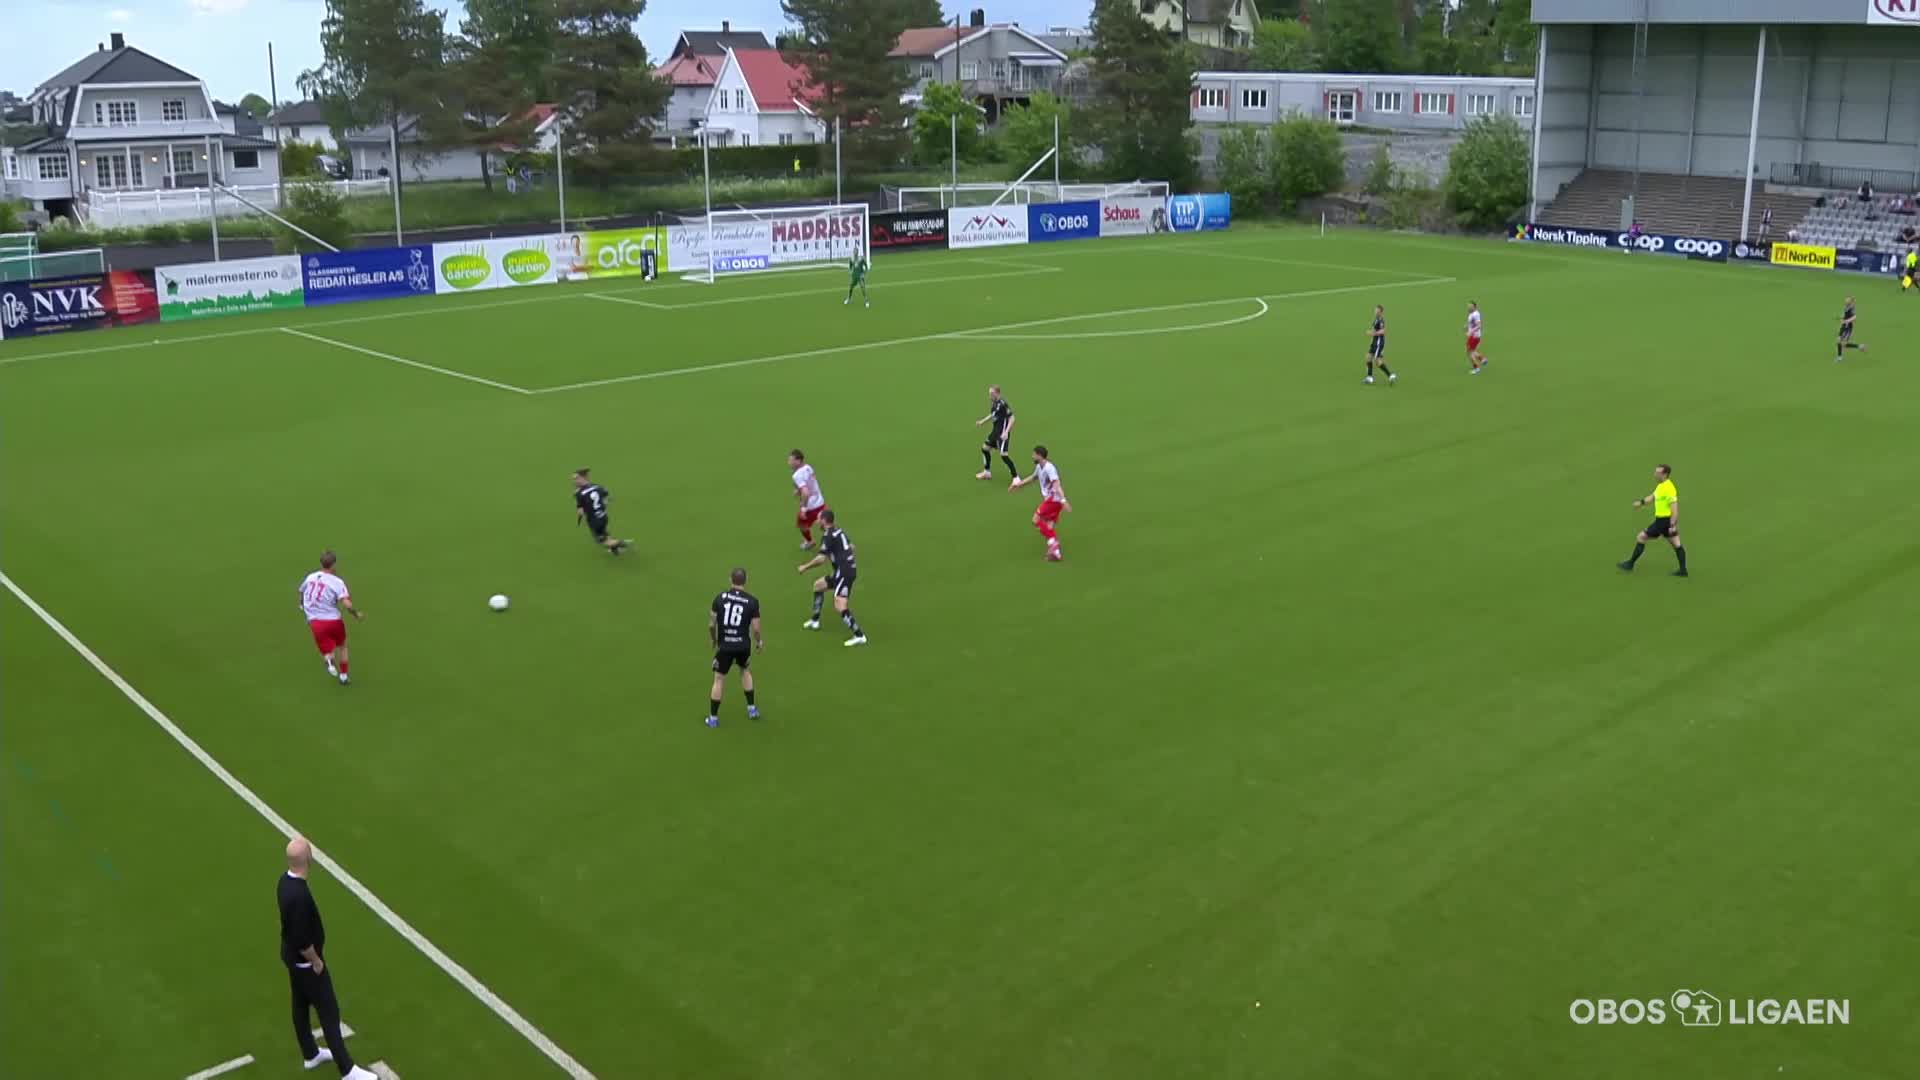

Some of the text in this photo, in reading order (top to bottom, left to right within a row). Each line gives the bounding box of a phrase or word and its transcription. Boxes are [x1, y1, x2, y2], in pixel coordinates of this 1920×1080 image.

[1104, 204, 1141, 221] Schaus
[772, 215, 861, 242] MADRASS
[1058, 215, 1089, 230] OBOS
[772, 239, 860, 254] EKSPERTEN
[1533, 228, 1607, 248] Norsk Tipping
[1674, 239, 1722, 258] coop
[731, 258, 765, 269] OBOS
[1788, 250, 1830, 265] NorDan
[186, 270, 278, 287] malermester.no
[308, 266, 355, 276] GLASSMESTER
[309, 269, 404, 290] REIDAR HESLER A/S
[31, 285, 104, 314] NVK
[590, 491, 601, 510] 2
